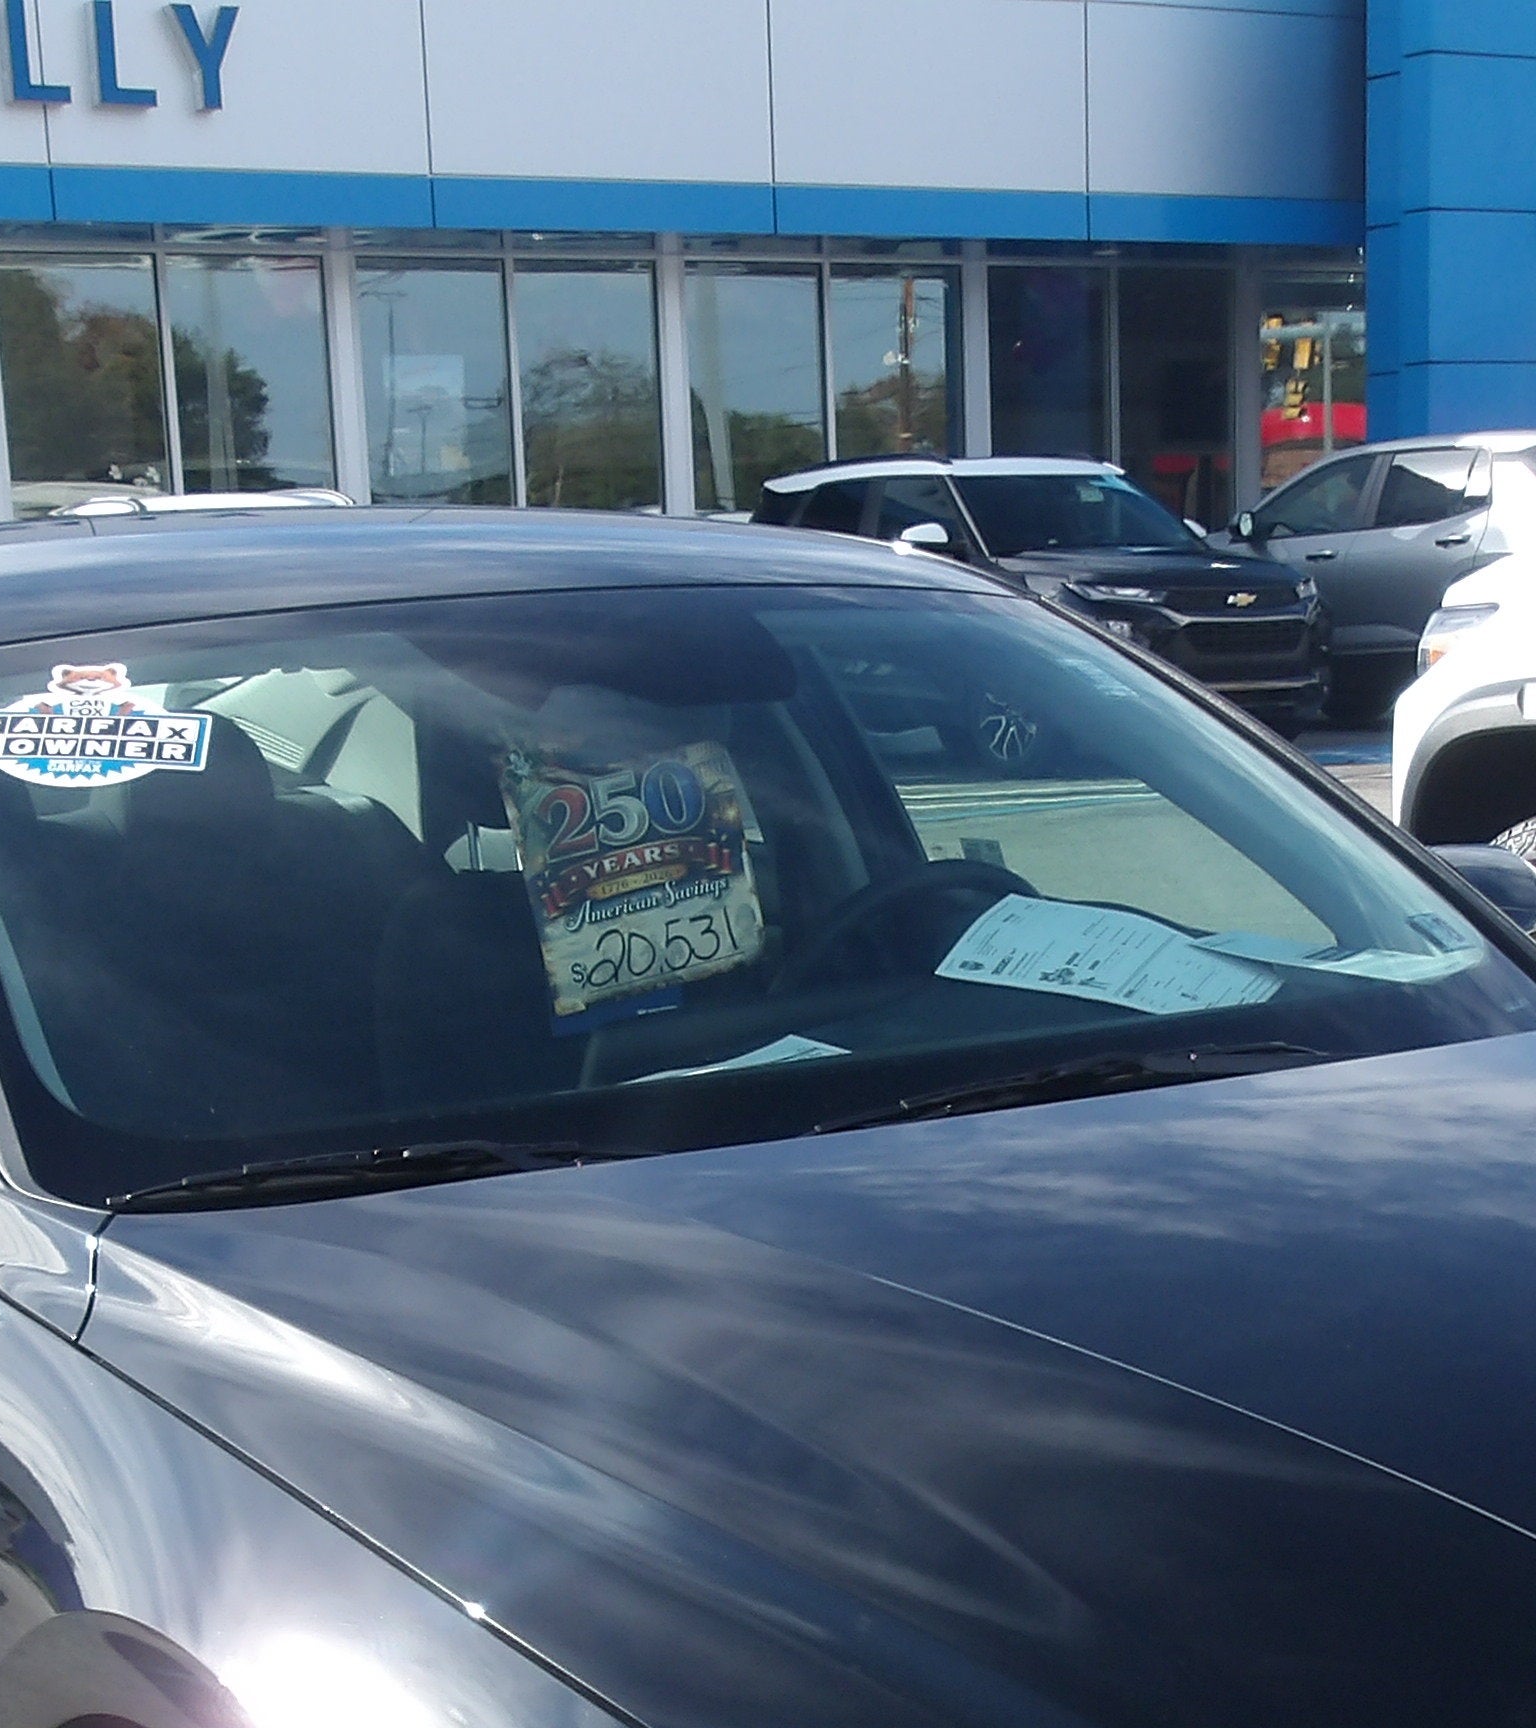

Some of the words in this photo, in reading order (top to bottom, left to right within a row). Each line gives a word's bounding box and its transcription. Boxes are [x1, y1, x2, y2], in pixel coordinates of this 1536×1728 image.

[69, 700, 105, 708] CAR
[69, 708, 103, 716] FOX
[9, 738, 186, 760] OWNER
[537, 760, 706, 863] 250
[583, 843, 681, 879] YEARS
[600, 881, 630, 895] 1776
[565, 895, 659, 932] American
[665, 875, 728, 908] Savings
